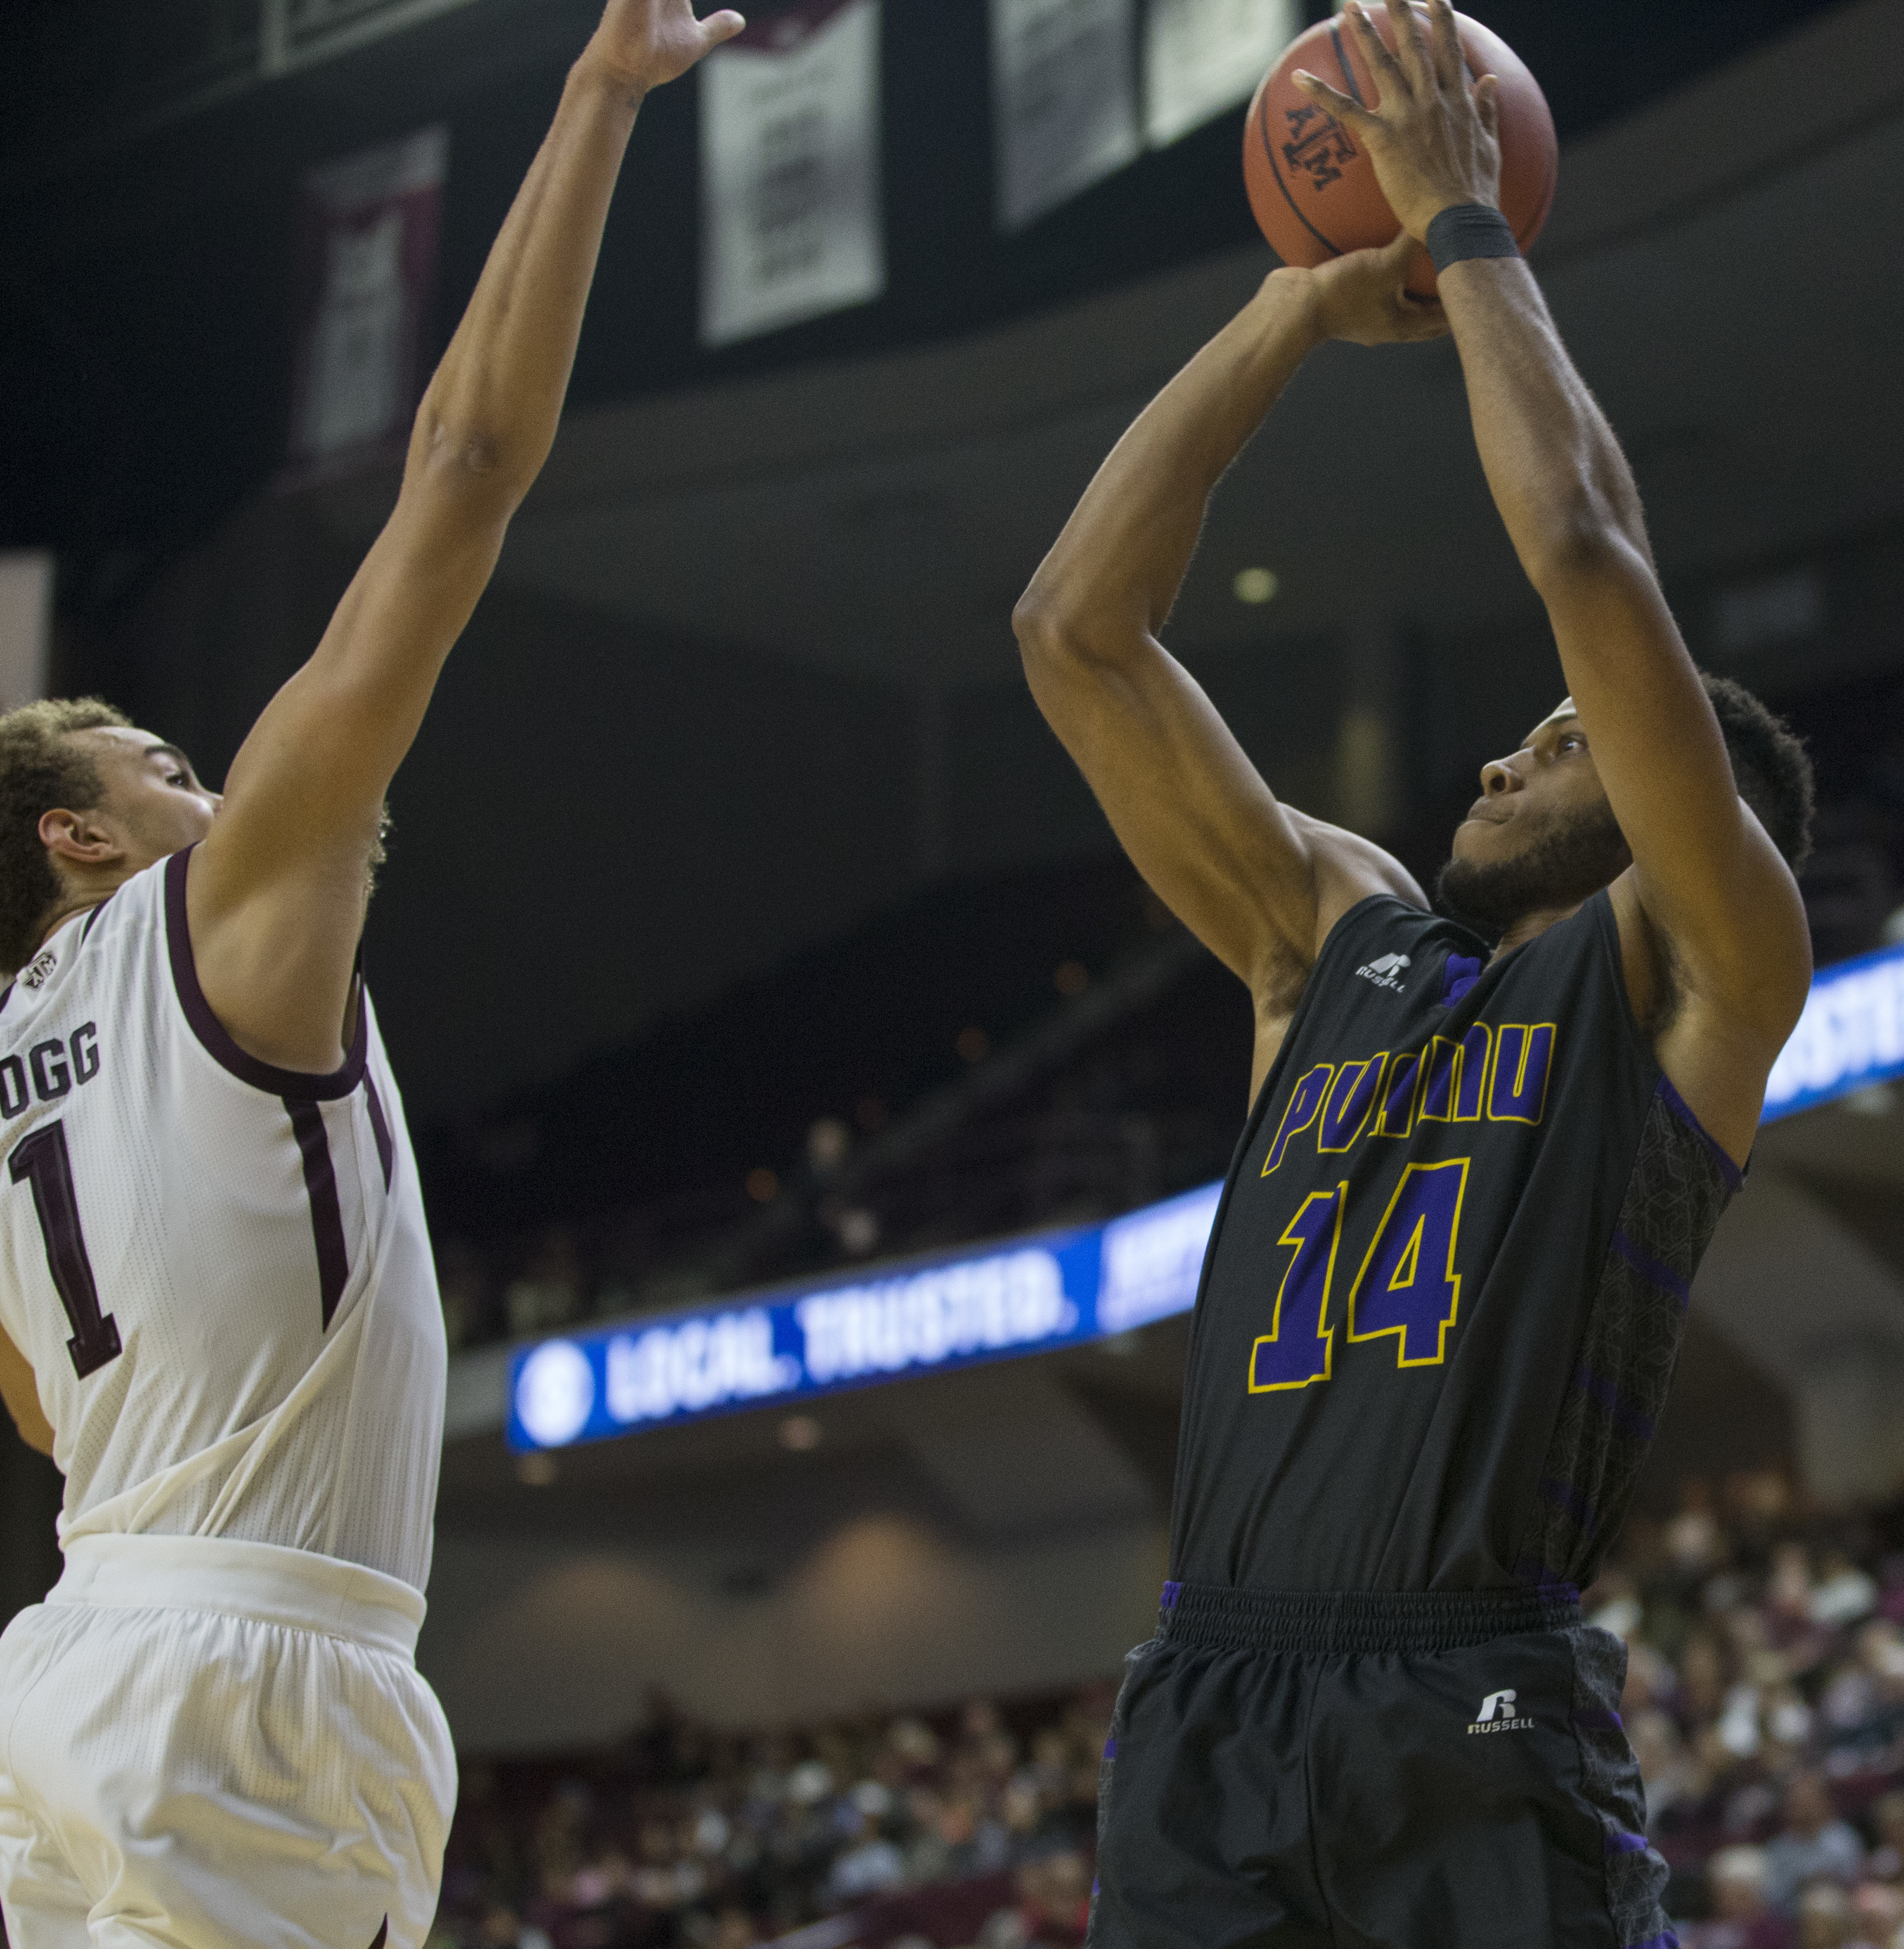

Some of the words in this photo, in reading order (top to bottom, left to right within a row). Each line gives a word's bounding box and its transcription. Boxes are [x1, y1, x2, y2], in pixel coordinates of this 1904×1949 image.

[8, 1119, 122, 1379] 1
[1248, 1157, 1471, 1393] 14
[1467, 1717, 1535, 1734] RUSSELL
